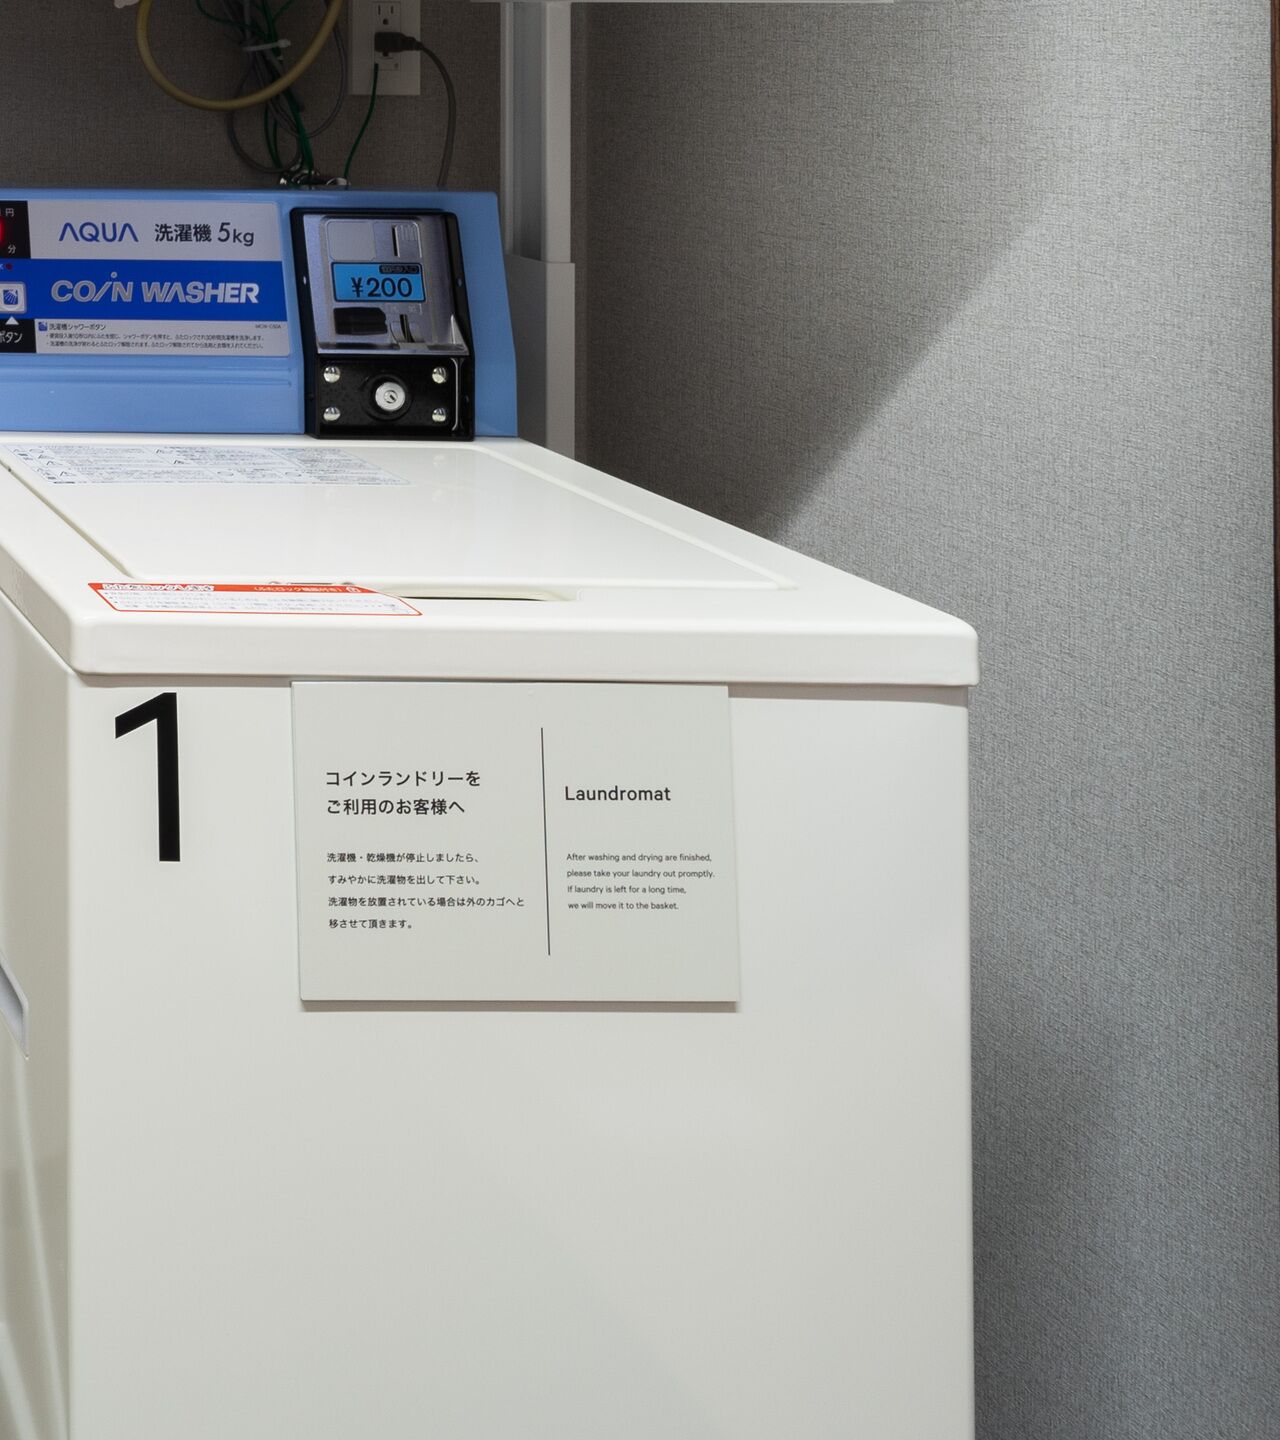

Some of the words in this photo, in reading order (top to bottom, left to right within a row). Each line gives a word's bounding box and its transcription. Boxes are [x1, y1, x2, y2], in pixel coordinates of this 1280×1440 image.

[5, 207, 15, 218] 円
[58, 221, 140, 243] AQUA
[154, 222, 213, 243] 洗濯機
[217, 221, 255, 248] 5kg
[7, 244, 17, 255] 分
[50, 271, 134, 303] COIN
[141, 280, 260, 304] WASHER
[350, 276, 413, 299] ¥200
[48, 322, 107, 331] 洗濯槽シャワーボタン
[114, 690, 182, 863] 1
[326, 770, 481, 787] コインランドリーを
[564, 784, 672, 802] Laundromat
[327, 797, 465, 816] ご利用のお客様へ
[326, 852, 479, 863] 洗濯機・乾燥機が停止しましたら、
[566, 852, 587, 862] After
[587, 853, 620, 863] washing
[621, 853, 637, 862] and
[637, 853, 664, 863] drying
[664, 854, 678, 862] are
[679, 853, 712, 862] finished,
[327, 874, 480, 886] すみやかに洗濯物を出して下さい。
[566, 869, 593, 878] please
[593, 869, 611, 878] take
[612, 871, 630, 879] your
[631, 869, 662, 879] laundry
[662, 870, 676, 878] out
[677, 869, 715, 879] promptly.
[567, 885, 573, 893] If
[574, 885, 604, 895] laundry
[605, 886, 613, 894] is
[613, 885, 627, 894] left
[628, 885, 640, 894] for
[648, 885, 666, 896] long
[666, 885, 687, 894] time,
[327, 896, 525, 908] 洗濯物を放置されている場合は外のカゴへと
[580, 901, 594, 909] will
[618, 902, 624, 910] it
[625, 902, 635, 910] to
[635, 901, 649, 910] the
[650, 901, 679, 910] basket.
[328, 918, 412, 930] 移させて頂きます。
